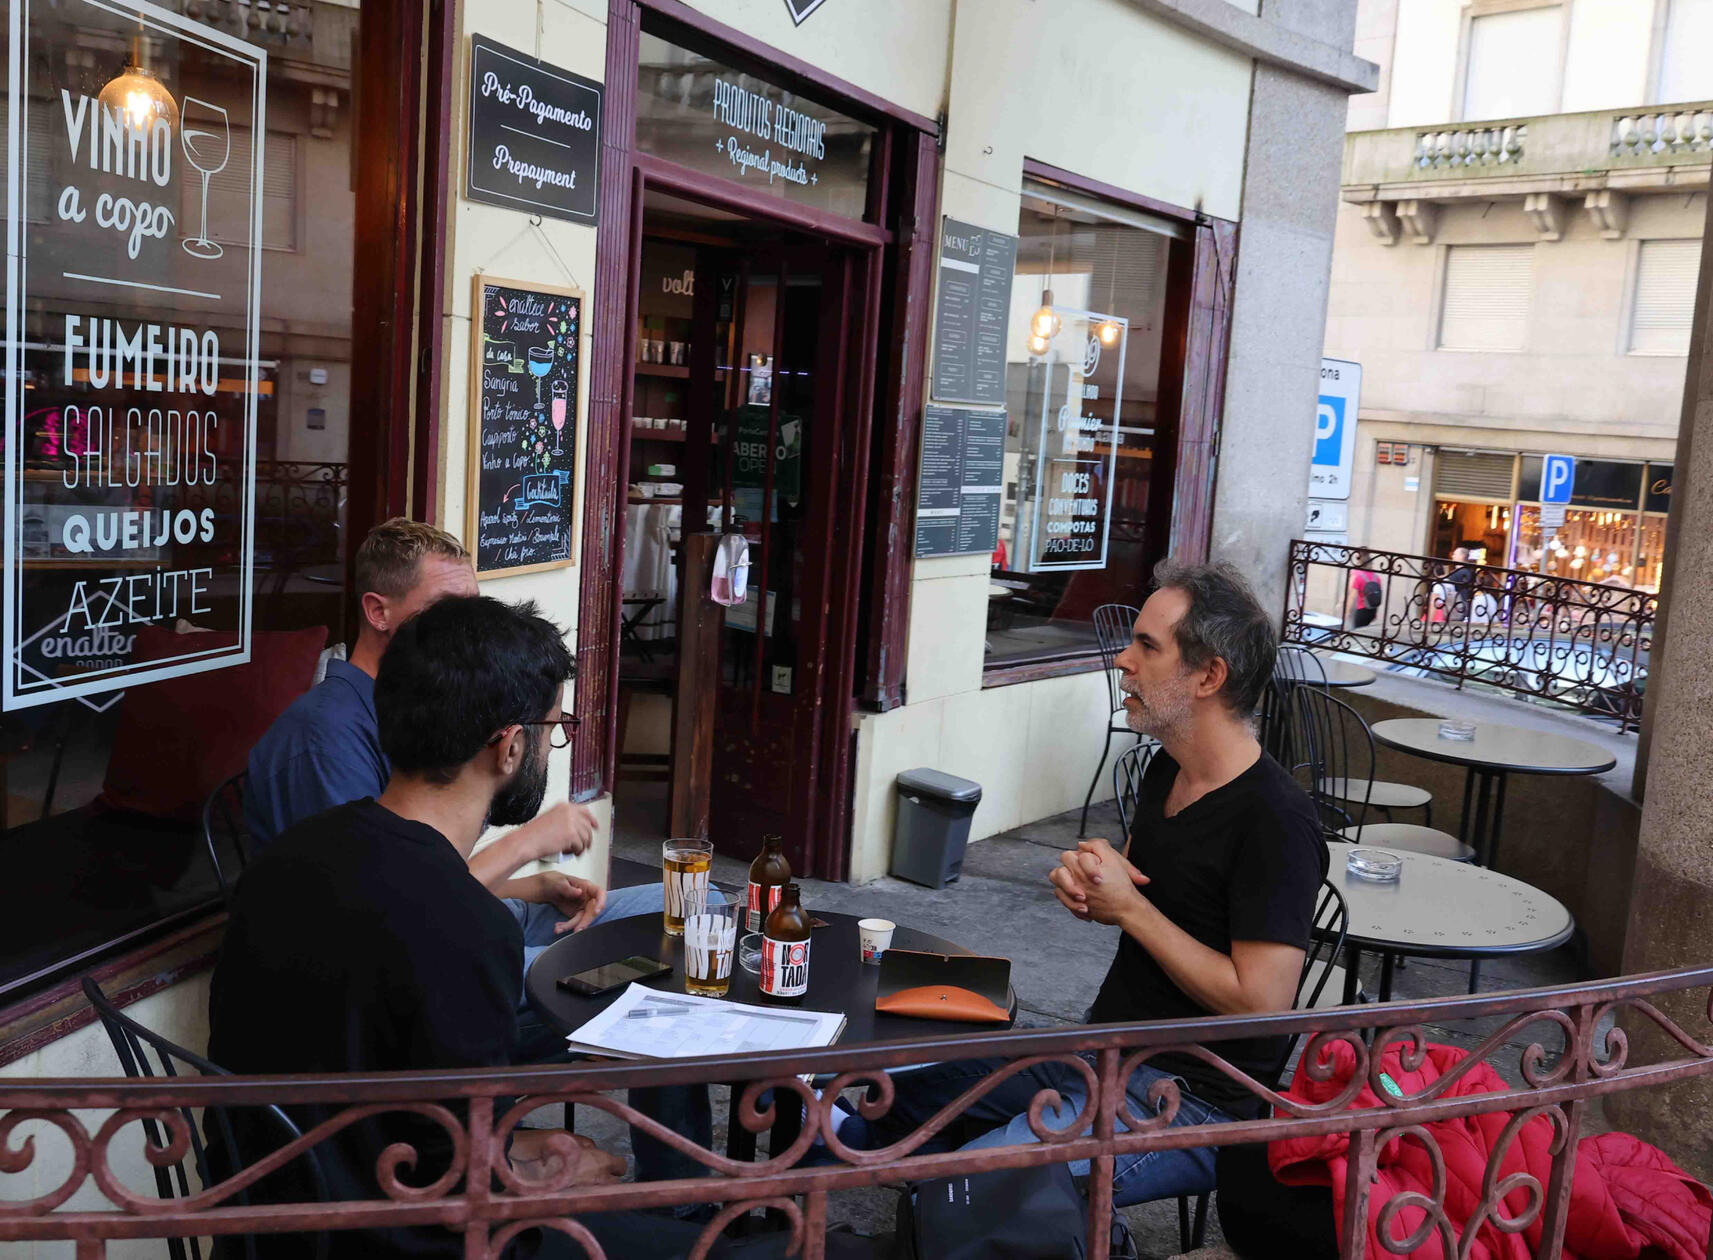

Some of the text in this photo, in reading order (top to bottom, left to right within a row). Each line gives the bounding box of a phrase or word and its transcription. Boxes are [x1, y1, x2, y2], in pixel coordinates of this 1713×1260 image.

[481, 72, 592, 132] Pré-Pagamento
[713, 78, 826, 160] PRODUTOS REGIONAIS
[61, 88, 171, 187] VINHO
[493, 145, 577, 189] Prepayment
[727, 136, 809, 185] Regional products
[58, 186, 175, 260] a copo
[944, 234, 968, 252] MENU
[64, 314, 219, 396] FUMEIRO
[1320, 367, 1340, 381] ona
[483, 368, 519, 397] Sangria
[62, 405, 218, 489] SALGADOS
[733, 441, 786, 461] ABERO
[738, 457, 769, 475] OPE
[1548, 459, 1569, 499] P
[1652, 479, 1673, 496] Ca
[62, 508, 215, 553] QUEIJOS
[1046, 521, 1097, 533] COMPOTAS
